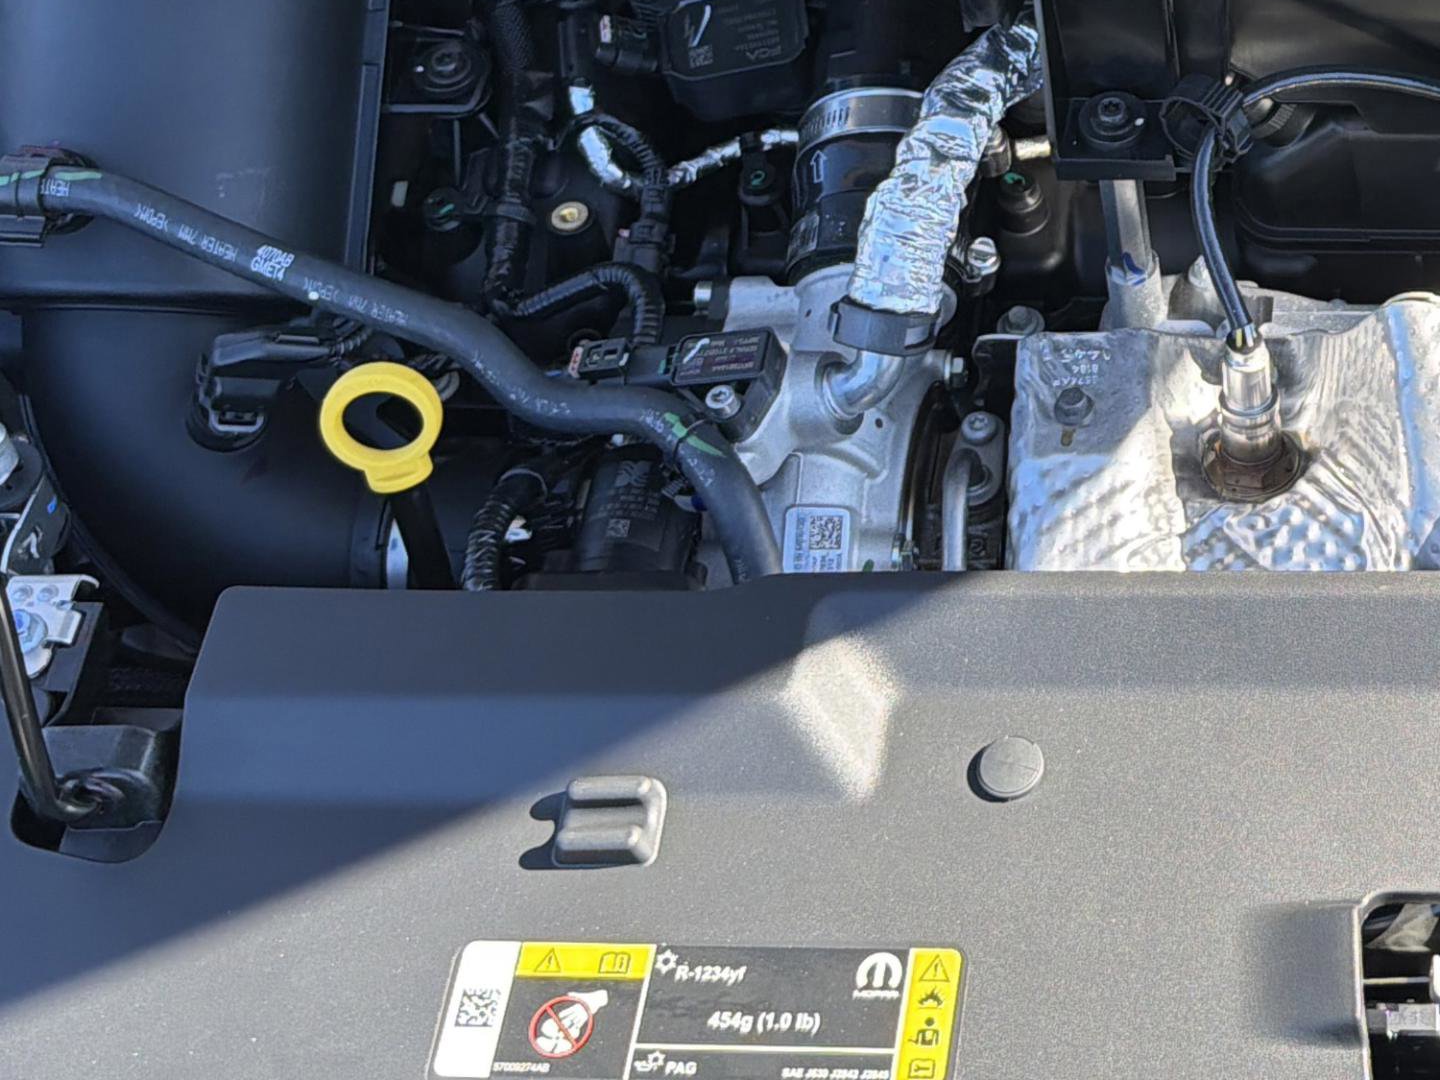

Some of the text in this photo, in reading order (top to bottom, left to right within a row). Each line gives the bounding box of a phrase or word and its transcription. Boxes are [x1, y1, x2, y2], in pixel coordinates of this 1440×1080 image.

[674, 965, 747, 985] R-1234yf
[707, 1011, 821, 1036] 454g (1.0 lb)
[665, 1061, 697, 1076] PAG
[781, 1067, 805, 1079] SAE
